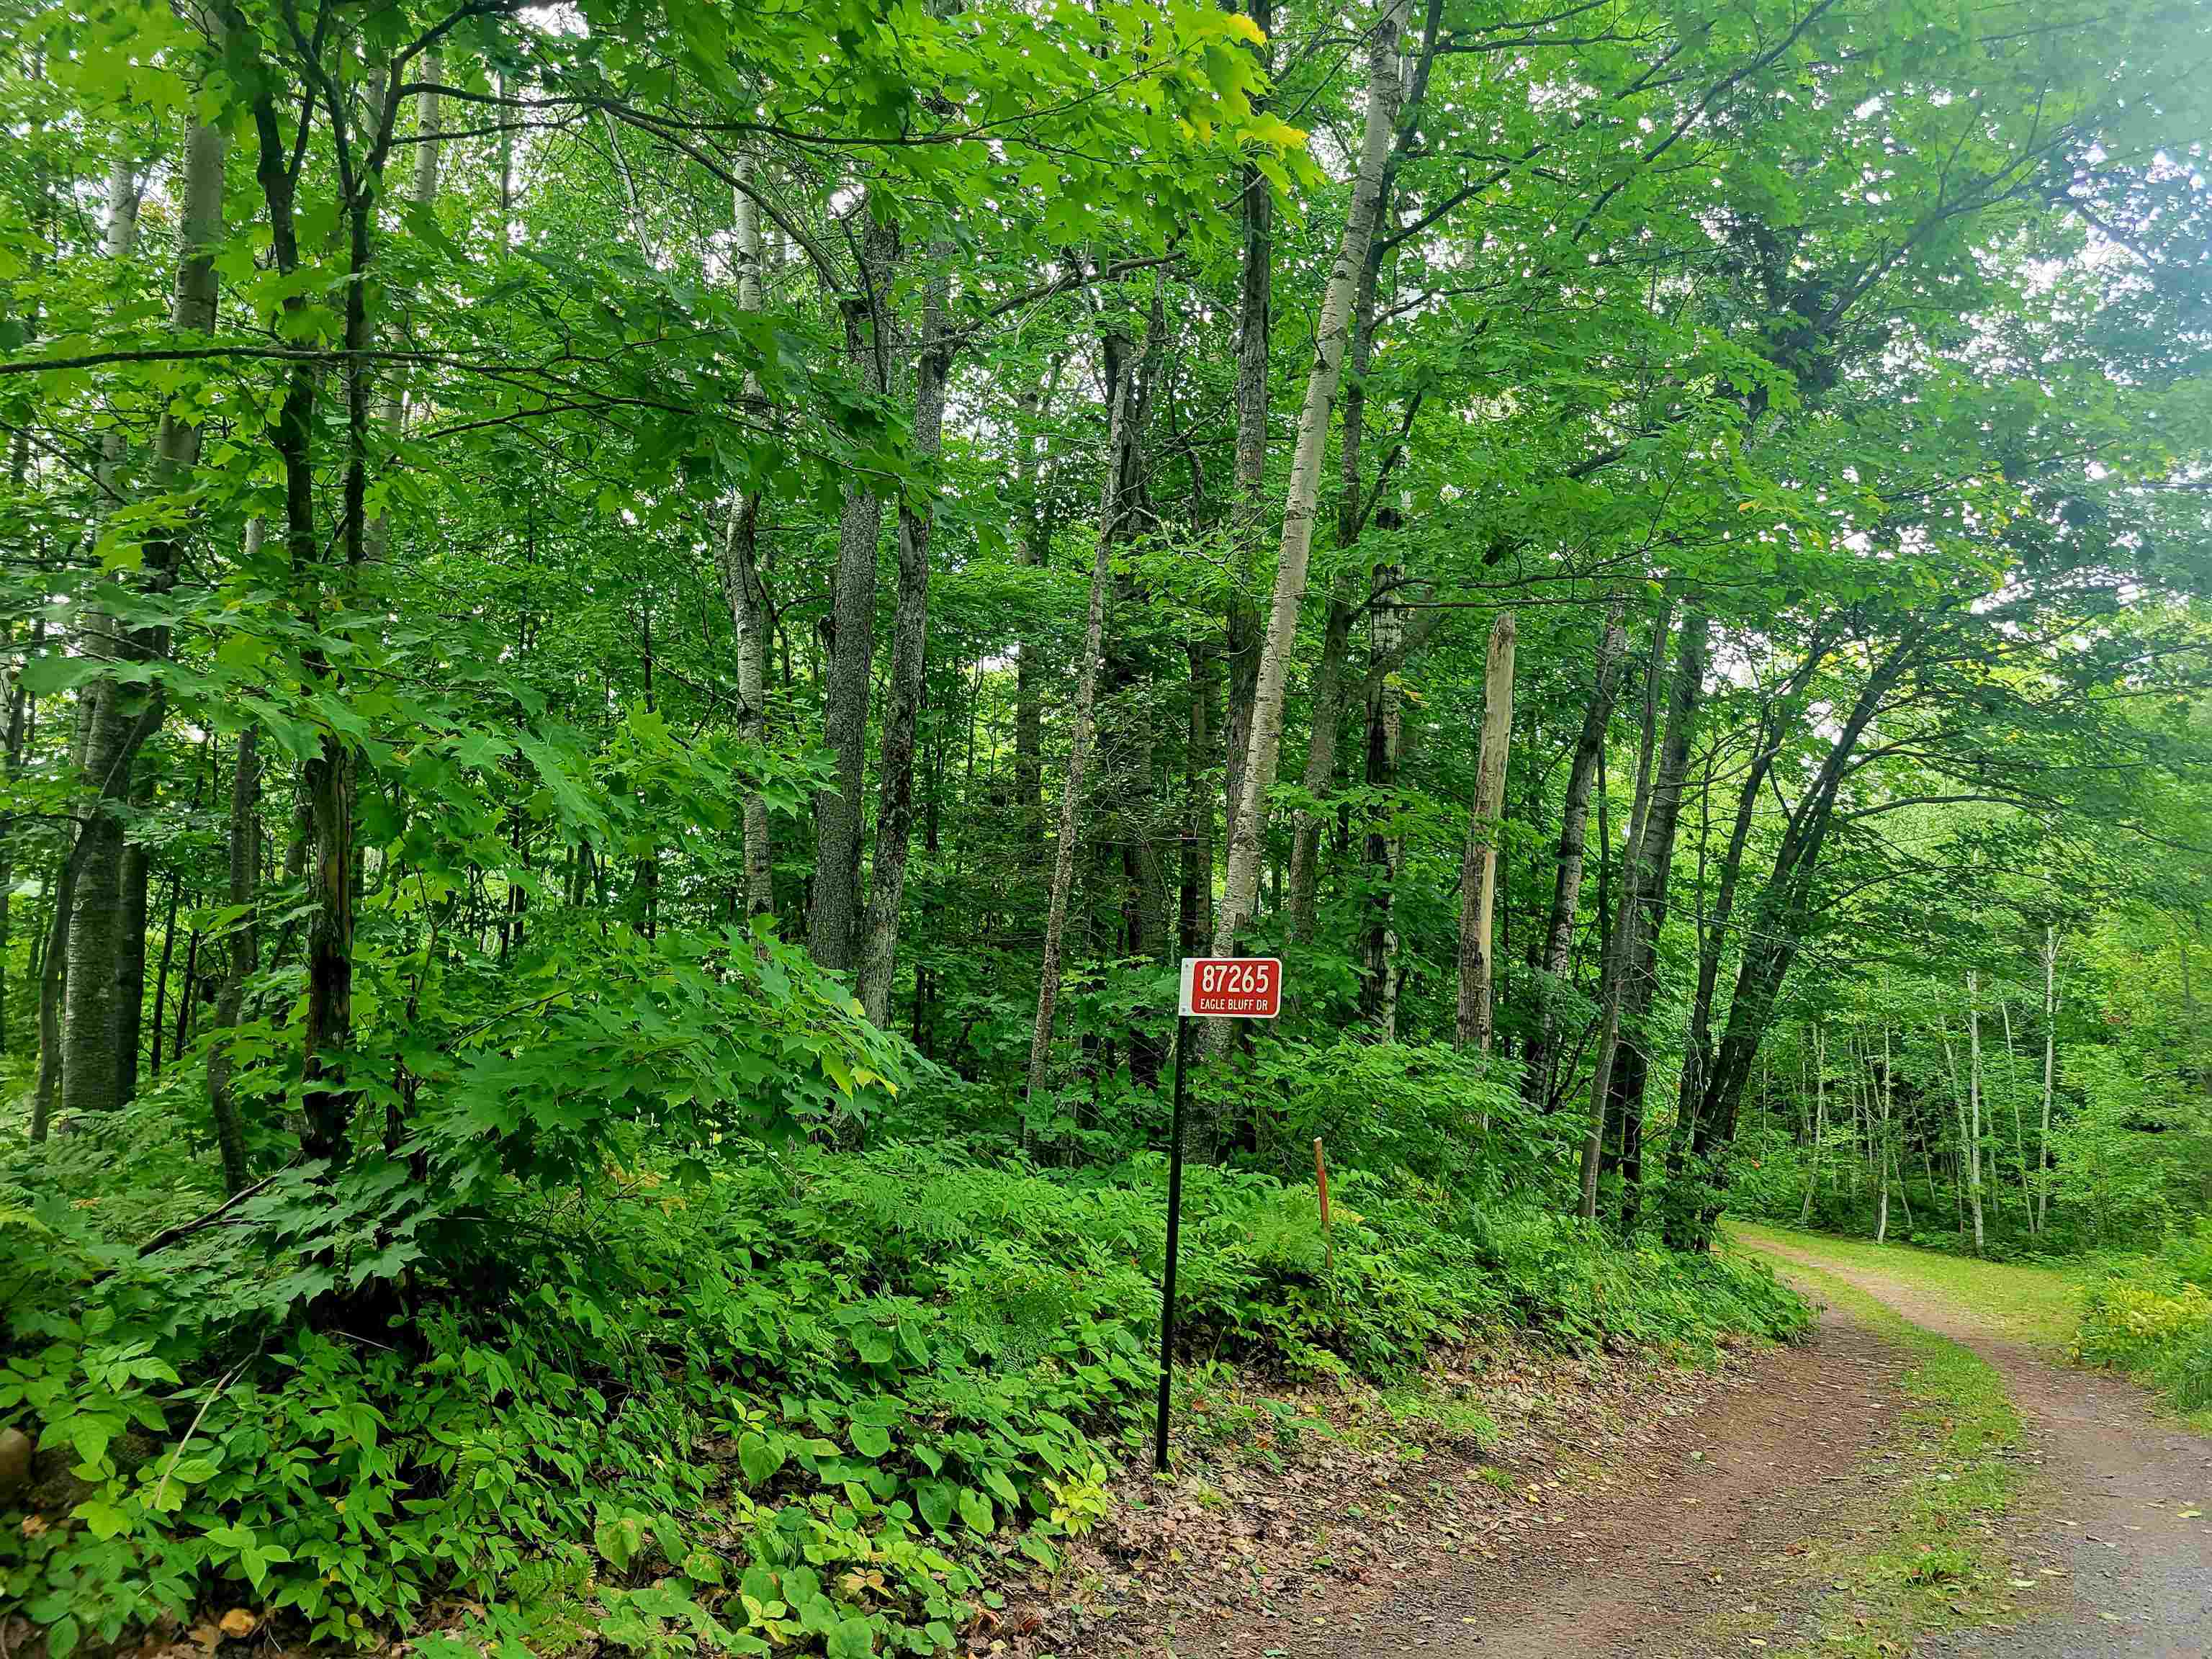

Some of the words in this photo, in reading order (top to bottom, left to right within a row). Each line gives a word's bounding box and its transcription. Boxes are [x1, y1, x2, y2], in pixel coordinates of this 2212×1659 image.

[1202, 965, 1269, 993] 87265
[1200, 998, 1225, 1010] EAGLE
[1228, 999, 1254, 1010] BLUFF
[1256, 999, 1268, 1011] DR
